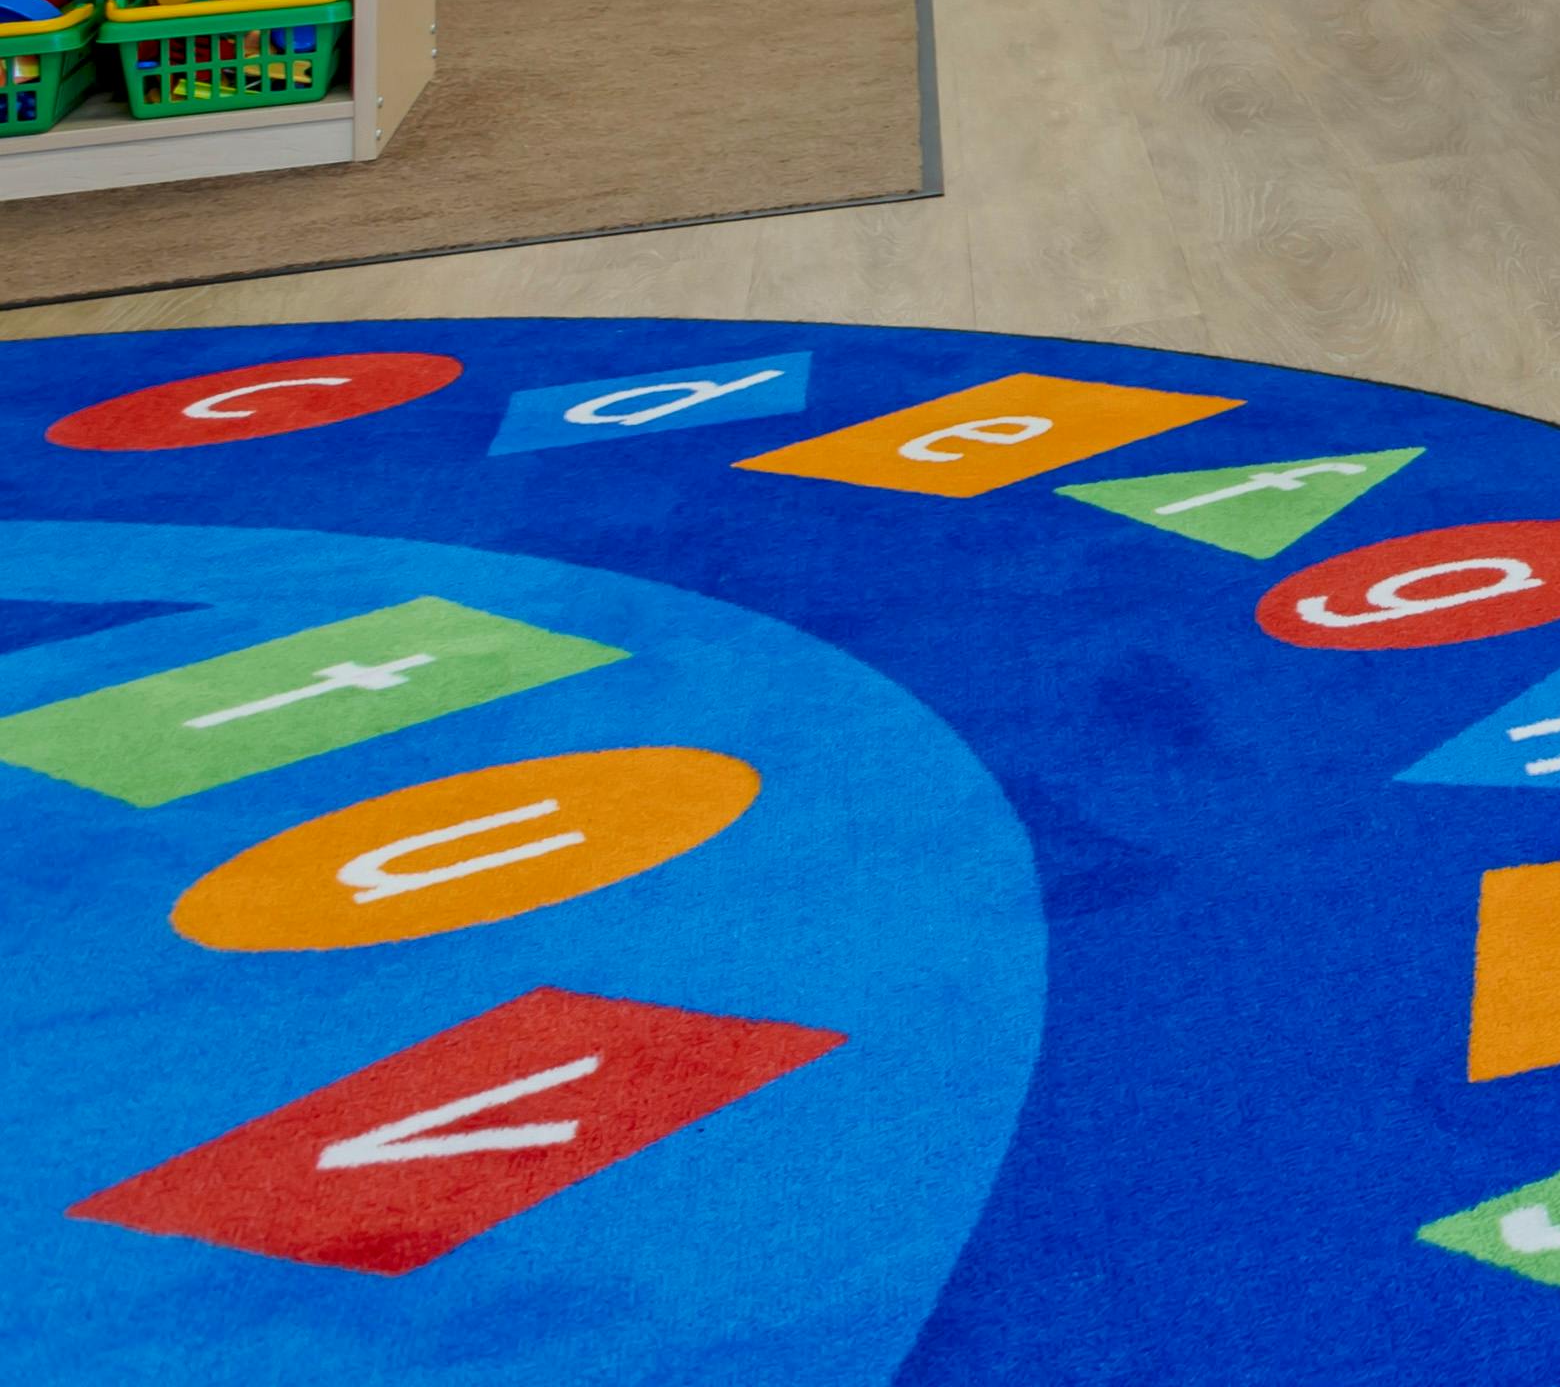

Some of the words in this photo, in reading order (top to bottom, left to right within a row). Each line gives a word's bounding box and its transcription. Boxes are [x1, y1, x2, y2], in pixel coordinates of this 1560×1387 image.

[563, 368, 785, 427] d
[896, 415, 1053, 462] e
[1153, 462, 1368, 515] f
[1295, 556, 1547, 628] g
[182, 653, 438, 728] t
[337, 798, 587, 905] u
